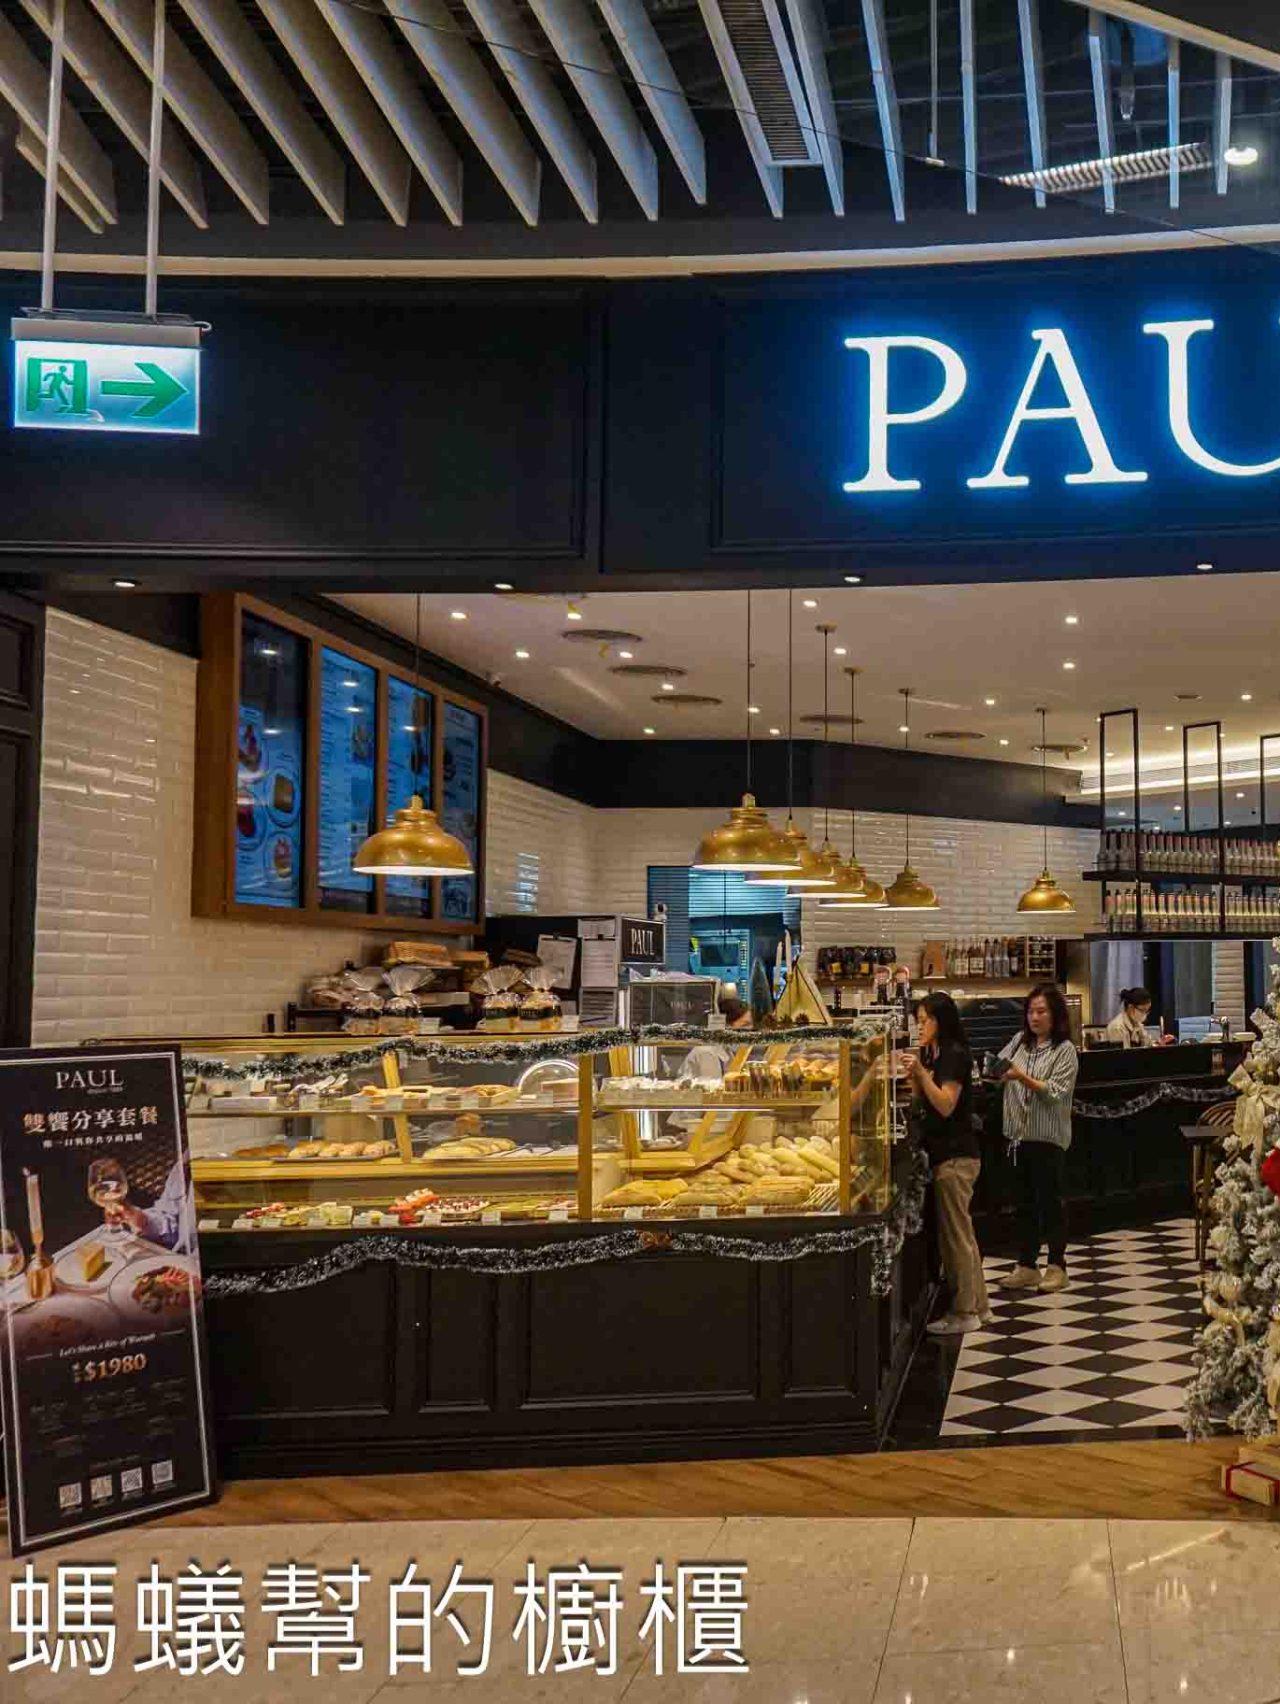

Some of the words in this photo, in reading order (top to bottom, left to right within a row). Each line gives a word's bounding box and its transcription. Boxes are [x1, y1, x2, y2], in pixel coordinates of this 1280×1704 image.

[631, 928, 655, 955] PAUL
[56, 1069, 124, 1089] PAUL
[23, 1105, 158, 1134] 雙饗分享套餐
[85, 1353, 147, 1381] $1980
